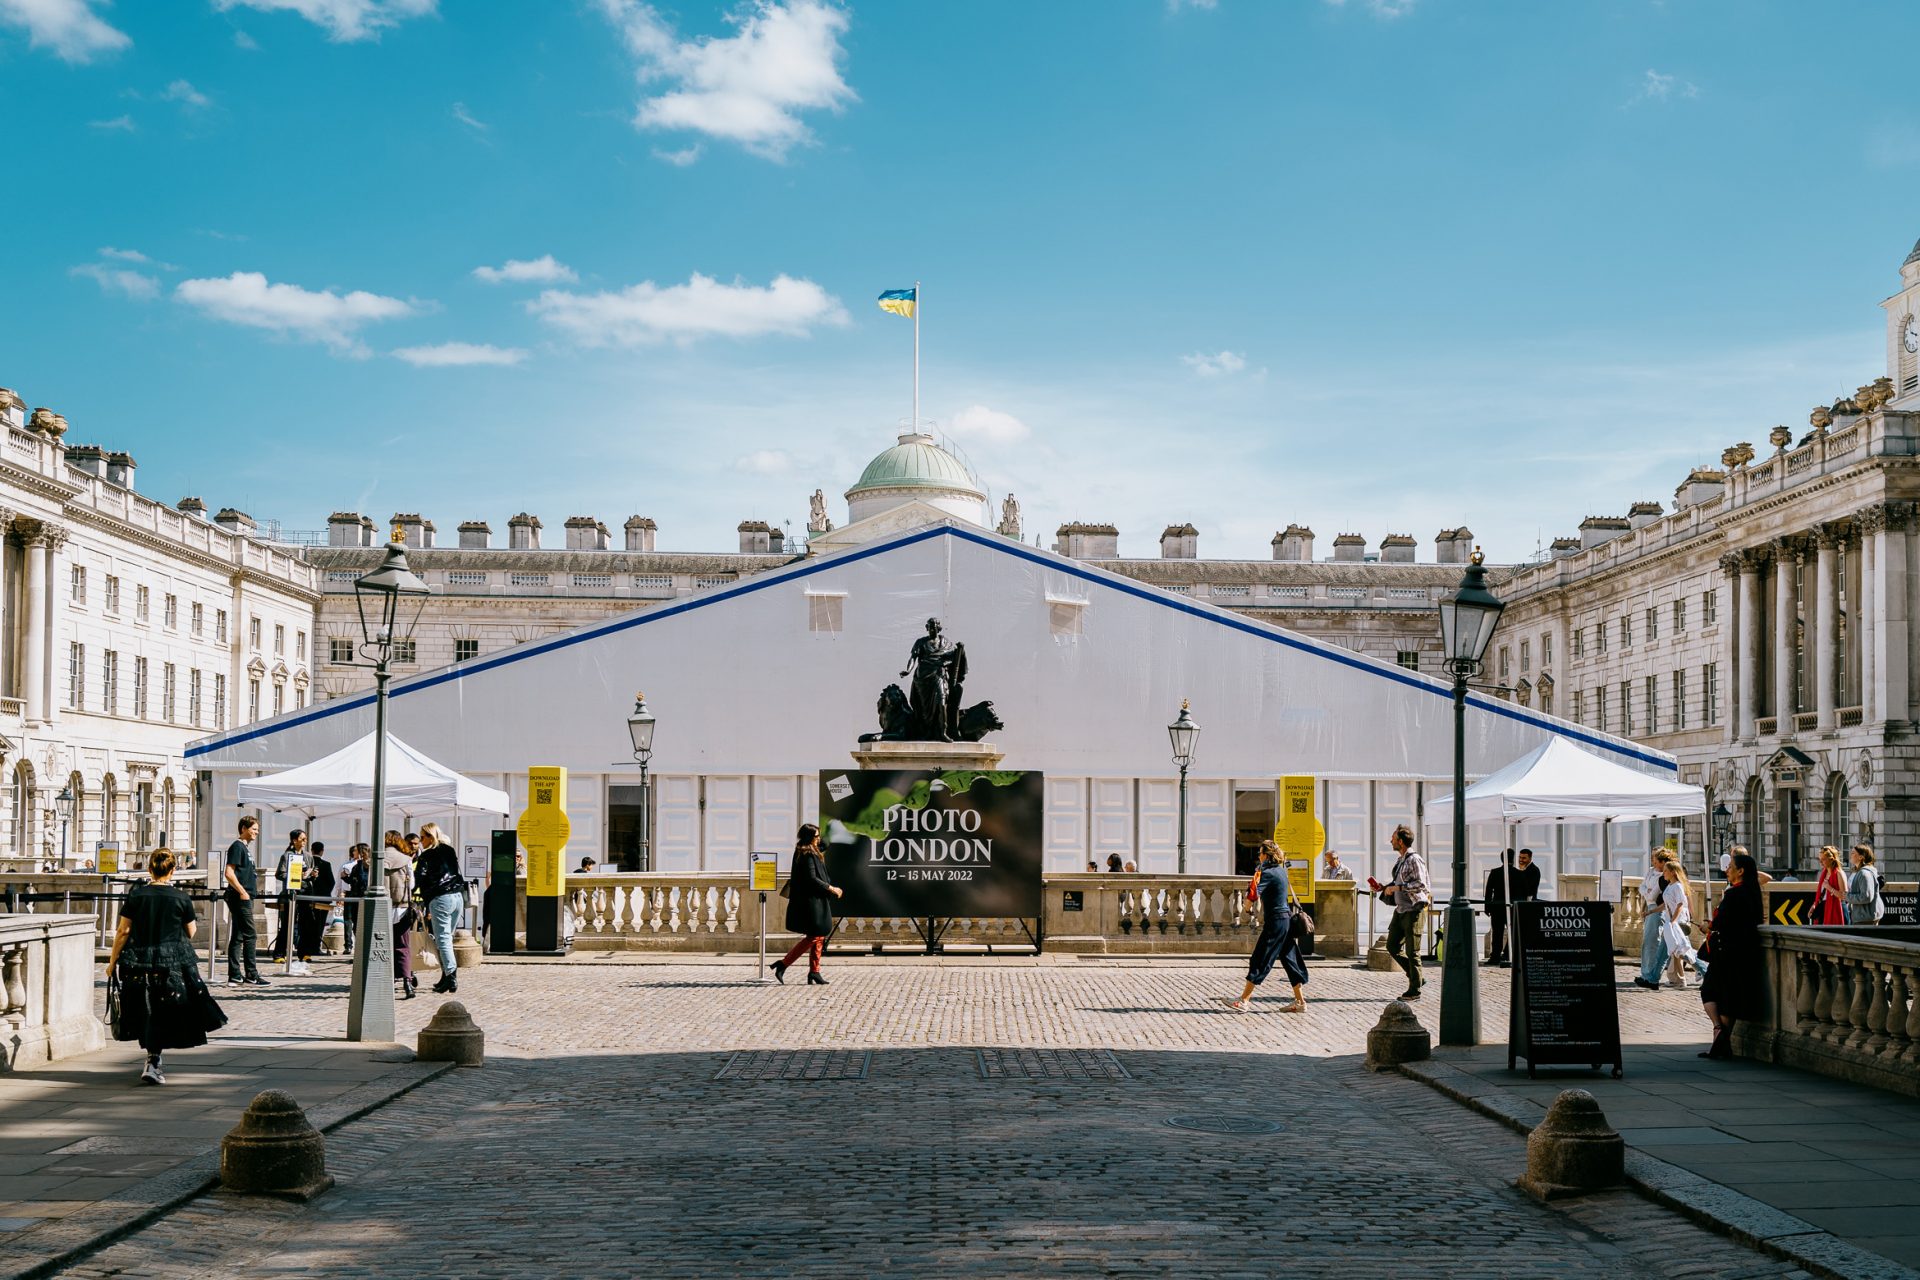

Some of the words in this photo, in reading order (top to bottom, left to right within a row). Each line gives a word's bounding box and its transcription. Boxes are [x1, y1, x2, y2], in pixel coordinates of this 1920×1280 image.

[882, 808, 982, 832] PHOTO
[869, 838, 993, 862] LONDON
[887, 870, 897, 881] 12
[908, 870, 919, 881] 15
[921, 870, 946, 881] MAY
[947, 870, 973, 881] 2022
[1885, 896, 1898, 904] VIP
[1544, 906, 1585, 917] PHOTO
[1540, 918, 1591, 929] LONDON
